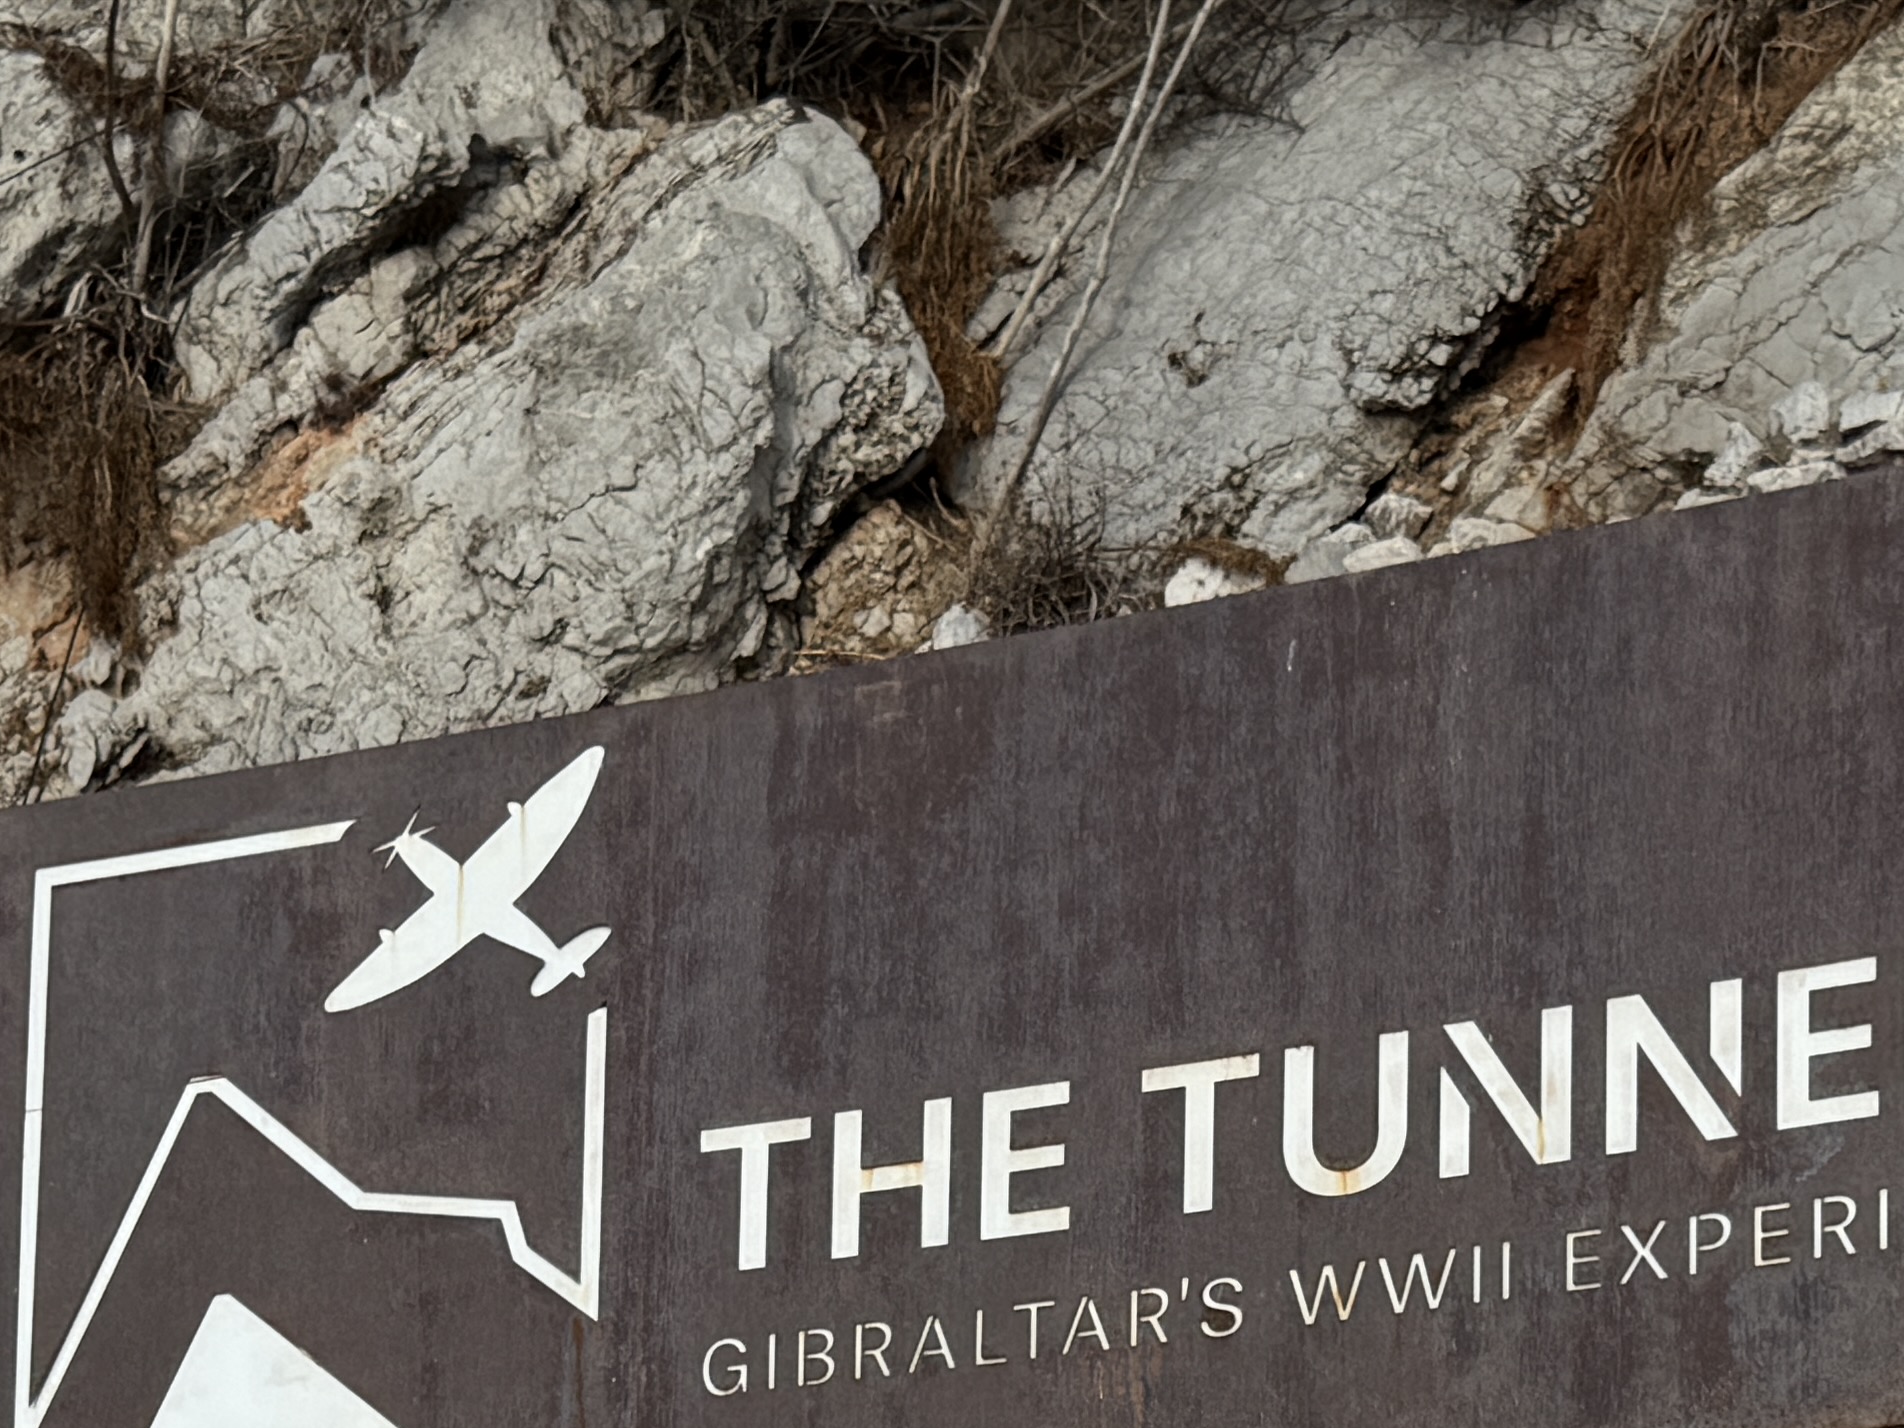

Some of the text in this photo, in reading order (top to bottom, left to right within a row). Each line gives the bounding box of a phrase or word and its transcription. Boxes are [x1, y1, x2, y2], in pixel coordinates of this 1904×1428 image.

[700, 1081, 1070, 1270] THE
[703, 1277, 1242, 1396] GIBRALTAR'S
[1289, 1242, 1510, 1325] WWII
